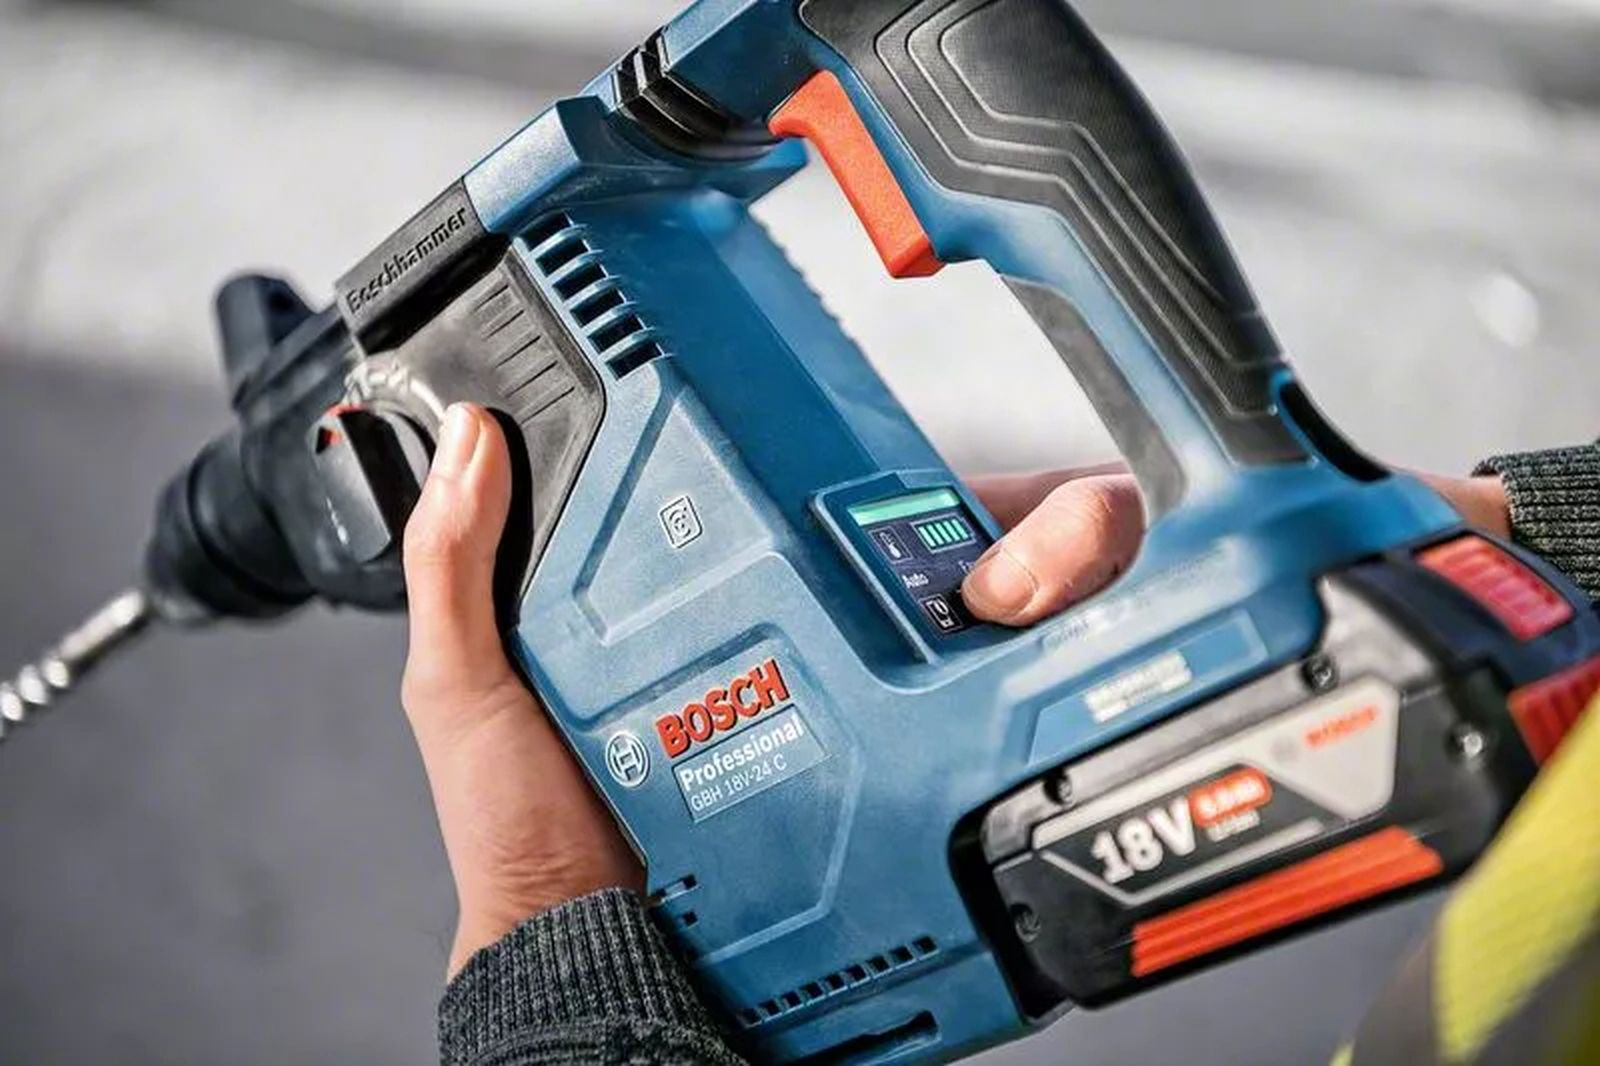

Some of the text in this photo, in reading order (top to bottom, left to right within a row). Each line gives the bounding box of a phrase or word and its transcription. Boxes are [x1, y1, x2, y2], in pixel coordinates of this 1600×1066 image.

[655, 658, 790, 758] BOSCH
[680, 714, 804, 792] Professional
[690, 753, 788, 812] GBH 18V-24 C
[1091, 798, 1197, 884] 18V
